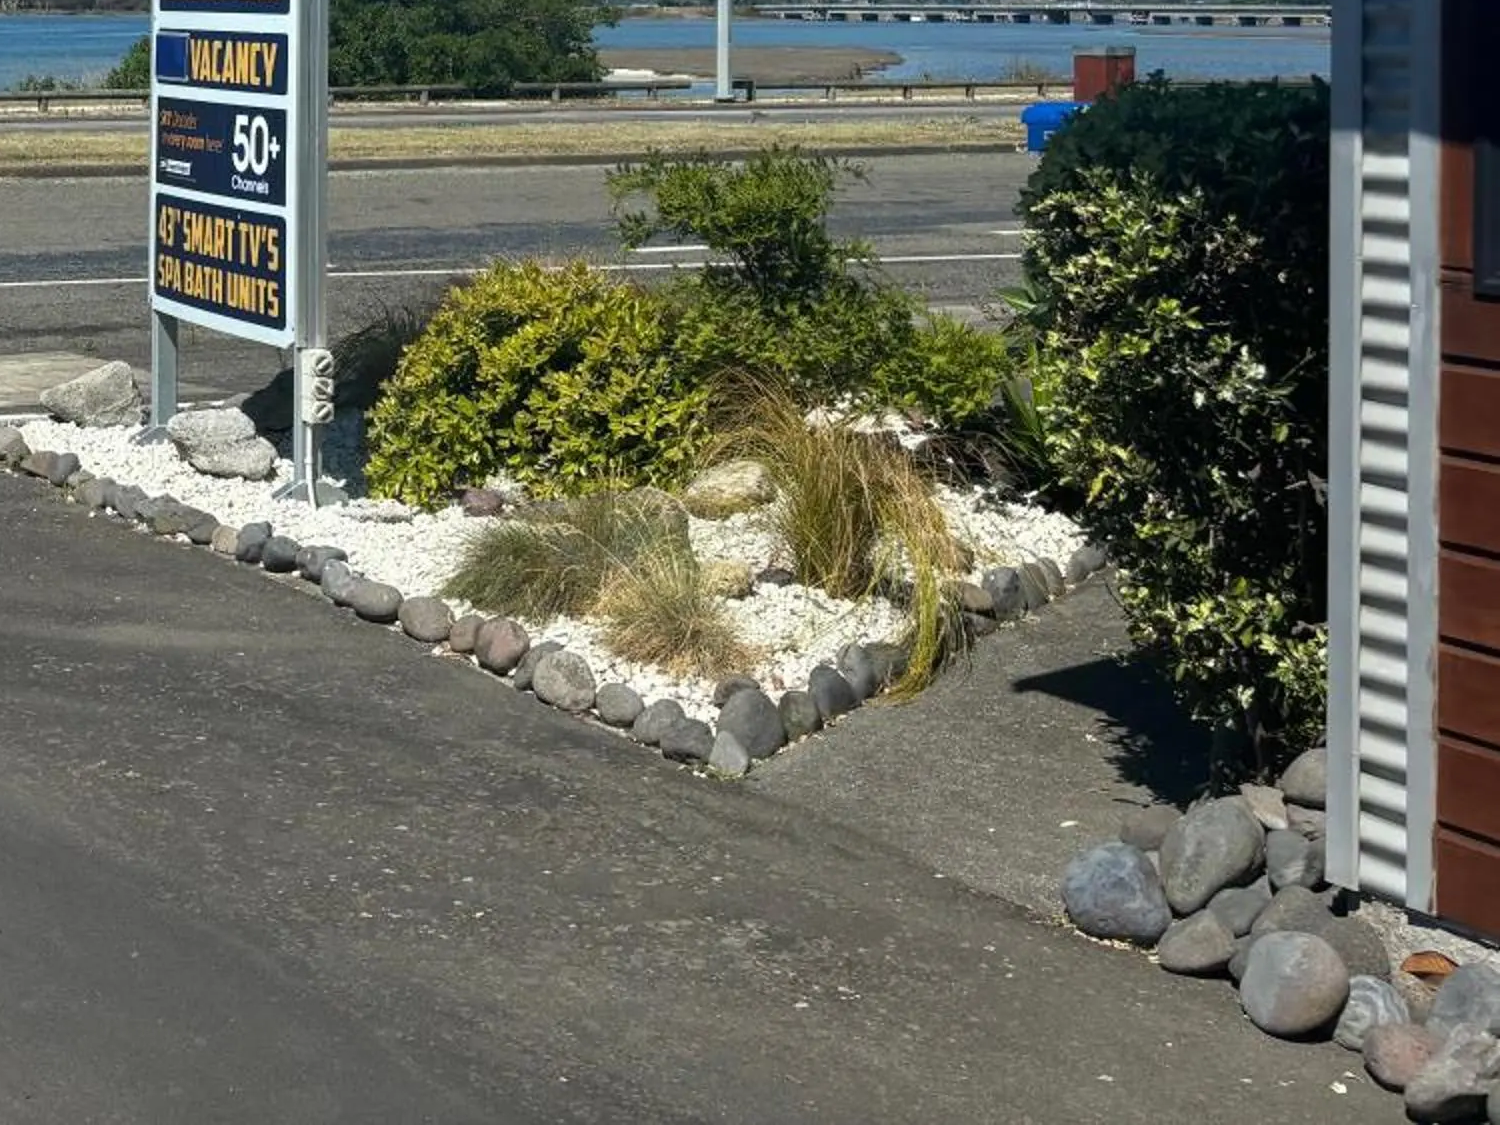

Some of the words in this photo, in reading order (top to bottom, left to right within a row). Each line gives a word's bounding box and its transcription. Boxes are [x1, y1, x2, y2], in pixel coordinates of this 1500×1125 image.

[190, 38, 278, 87] VACANCY
[232, 114, 280, 175] 50+
[231, 174, 269, 195] Channels
[183, 211, 235, 262] SMART
[238, 222, 279, 272] TV'S
[158, 254, 181, 292] SPA
[184, 261, 223, 304] BATH
[227, 271, 279, 318] UNITS
